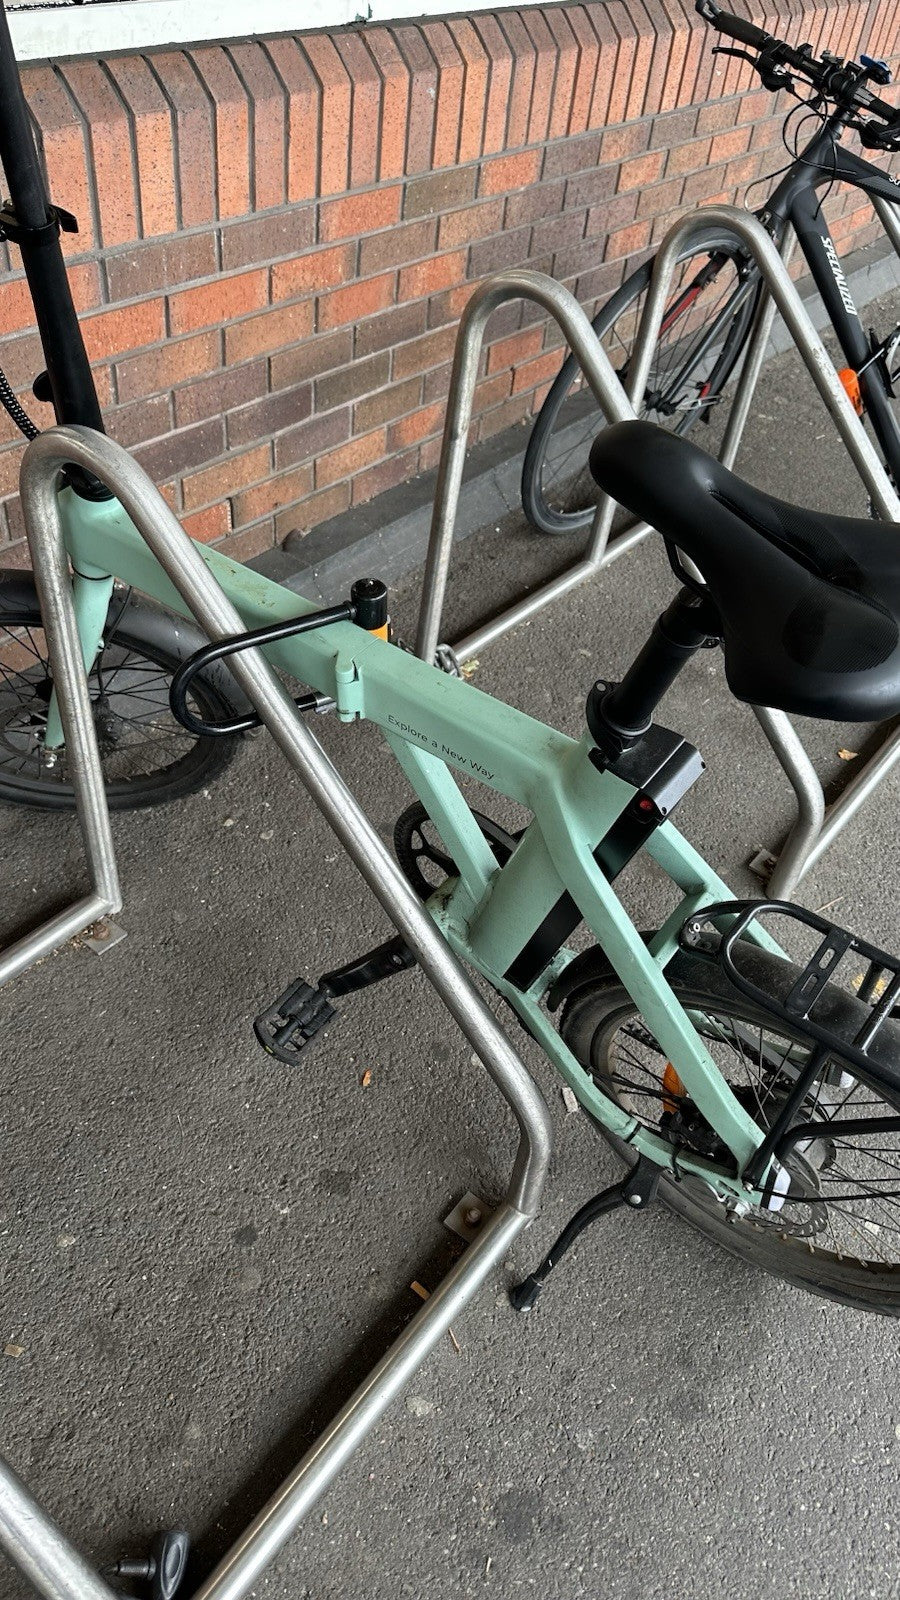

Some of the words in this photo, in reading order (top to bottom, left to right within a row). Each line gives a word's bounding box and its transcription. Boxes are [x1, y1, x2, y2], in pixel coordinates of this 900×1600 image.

[821, 235, 858, 316] SPECIALIZED
[388, 714, 428, 742] Explore
[431, 740, 438, 748] a
[441, 744, 467, 764] New
[469, 759, 495, 780] Way
